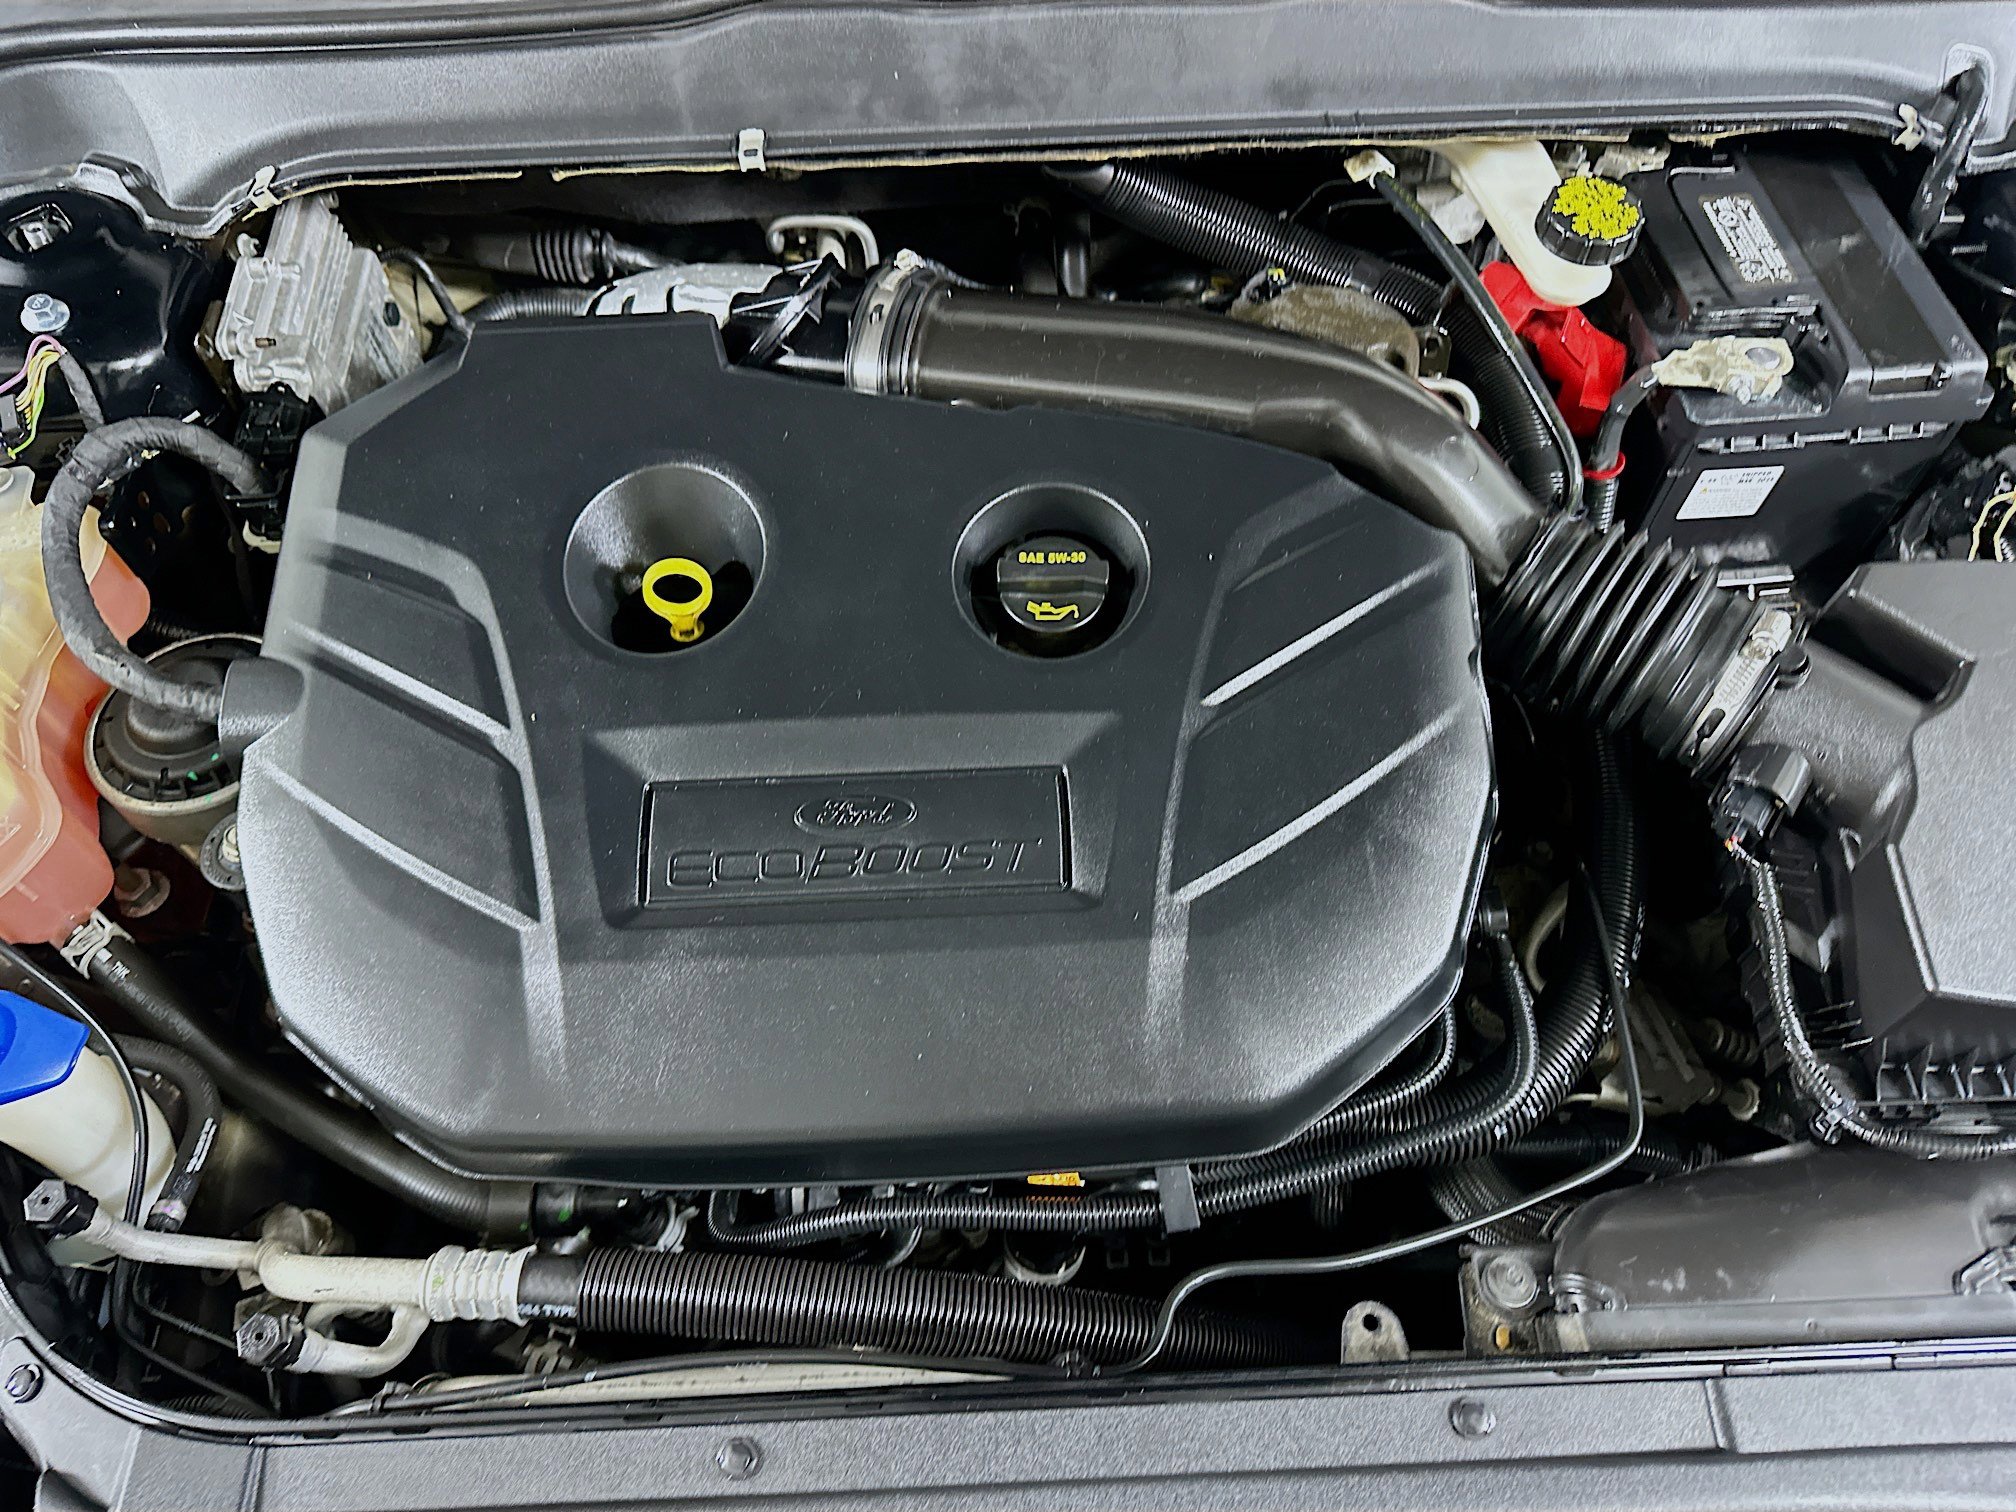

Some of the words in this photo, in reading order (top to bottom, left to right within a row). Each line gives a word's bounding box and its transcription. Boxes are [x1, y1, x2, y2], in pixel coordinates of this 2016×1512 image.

[1018, 551, 1045, 564] SAE
[1047, 551, 1087, 564] 5W-30
[816, 799, 894, 827] Ford
